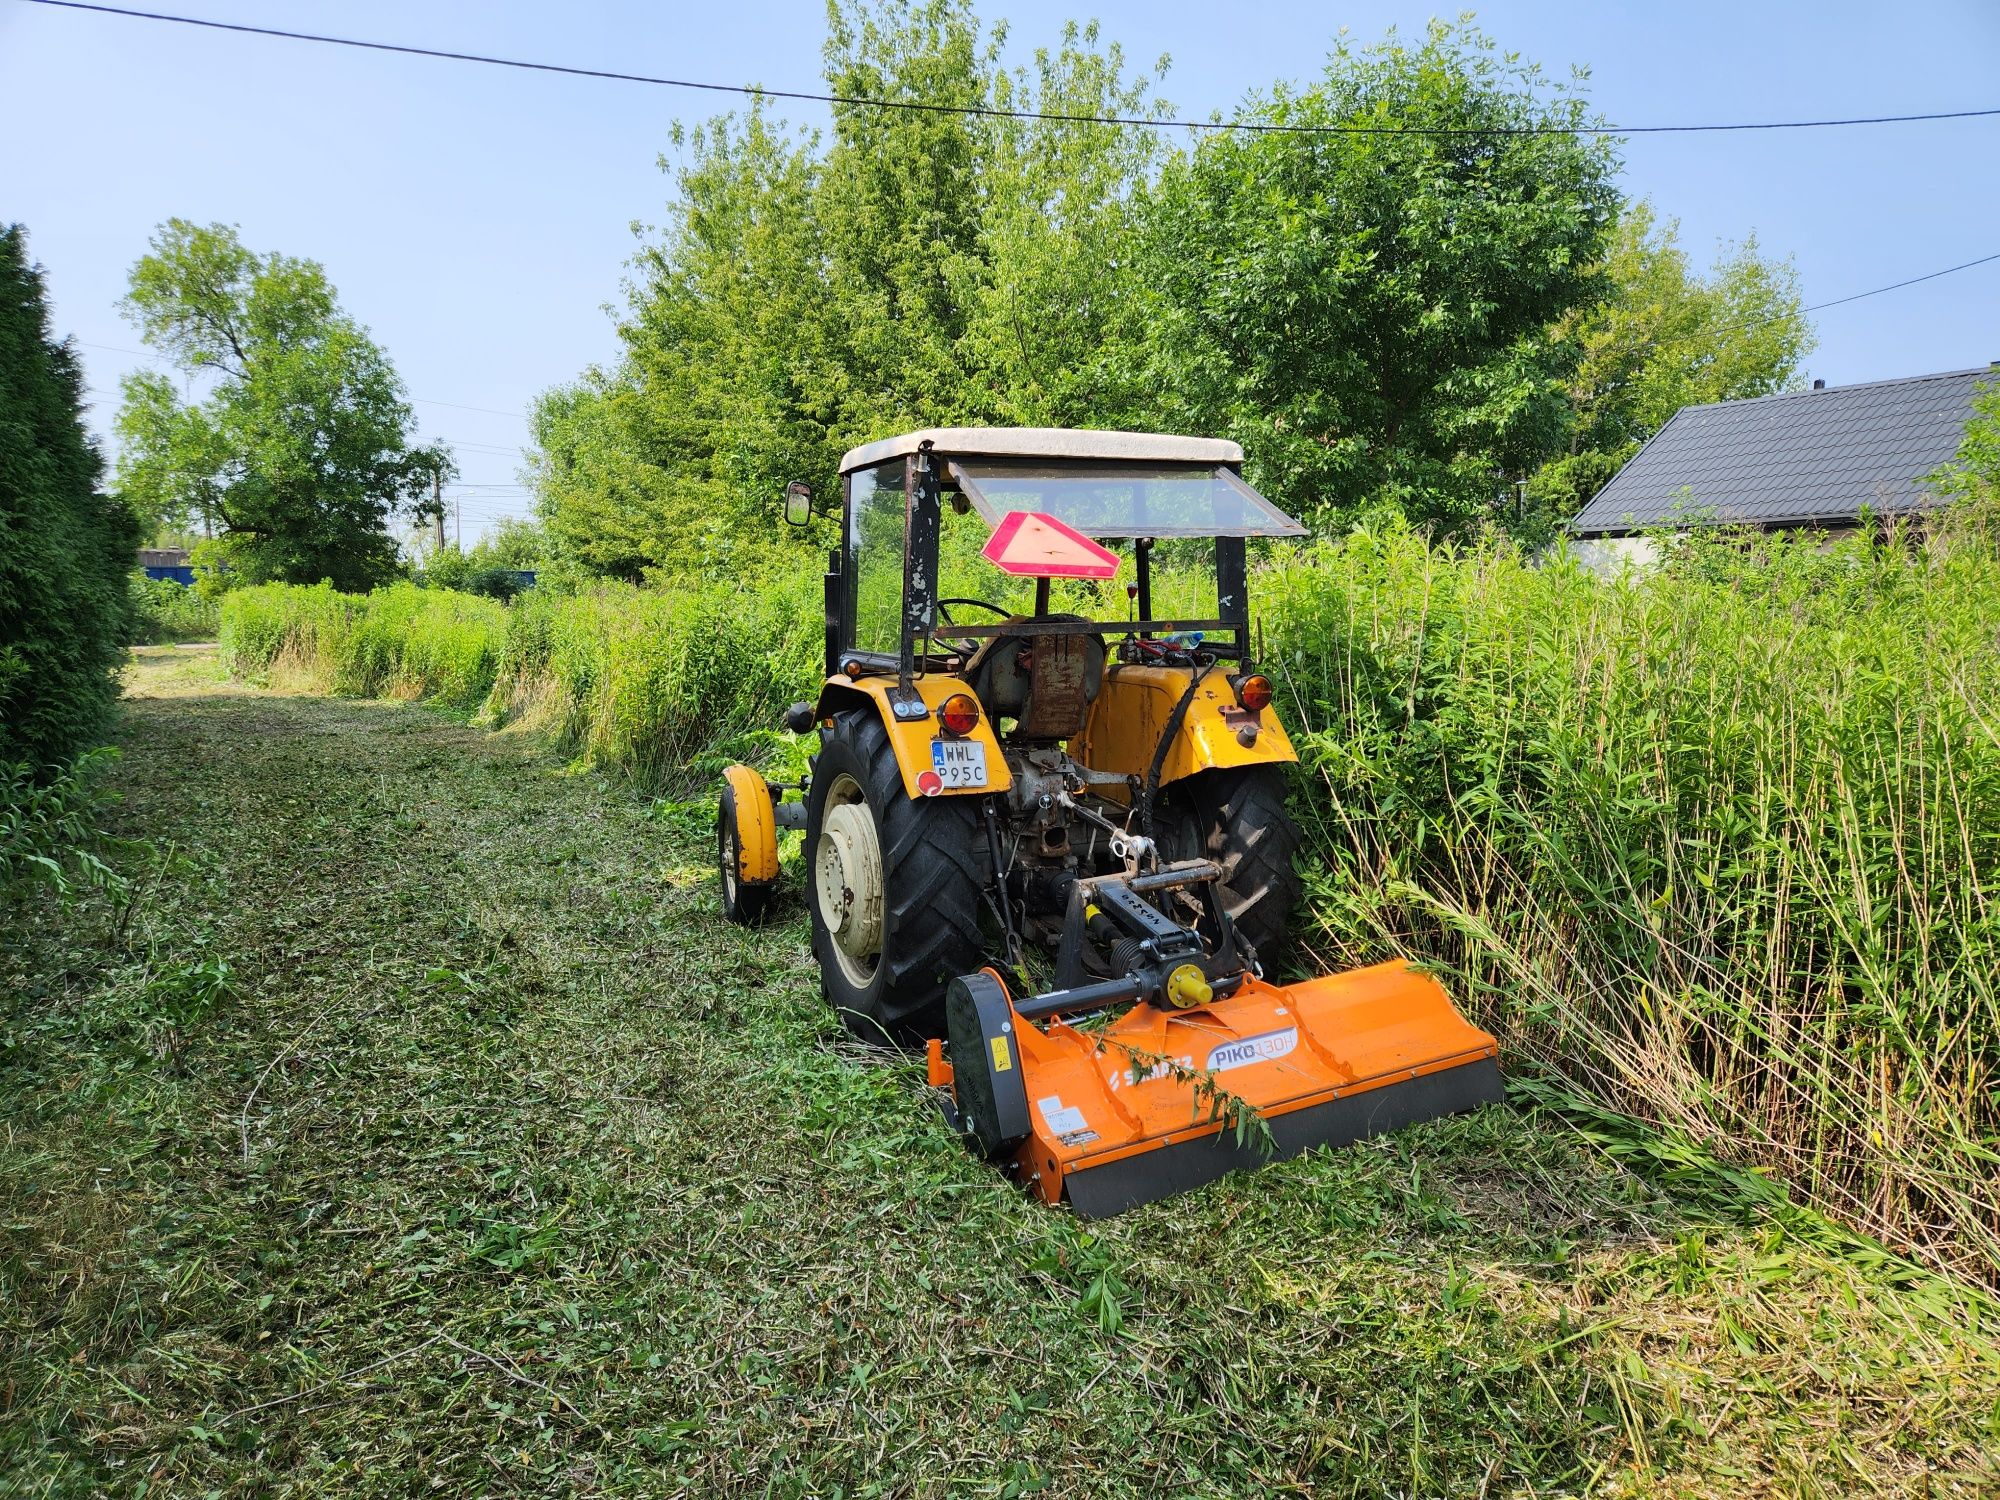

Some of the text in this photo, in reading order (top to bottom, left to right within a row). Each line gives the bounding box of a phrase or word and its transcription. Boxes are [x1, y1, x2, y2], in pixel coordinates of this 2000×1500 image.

[934, 755, 944, 764] PL
[945, 746, 975, 762] WWL
[1215, 1044, 1256, 1067] PIKO
